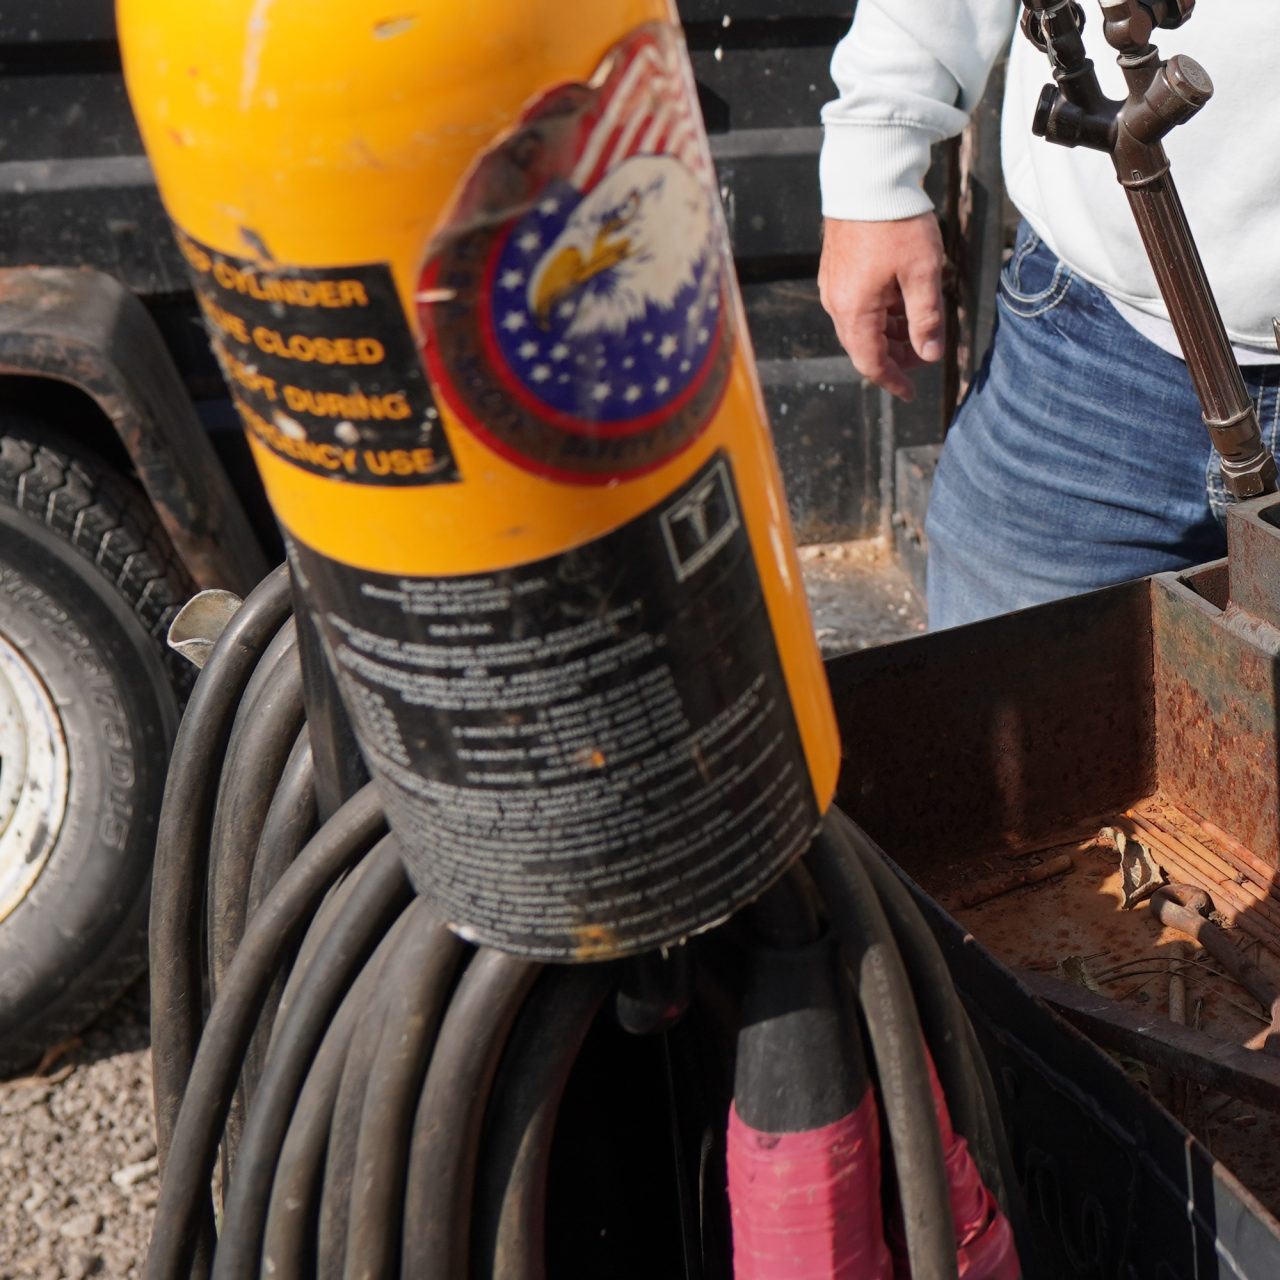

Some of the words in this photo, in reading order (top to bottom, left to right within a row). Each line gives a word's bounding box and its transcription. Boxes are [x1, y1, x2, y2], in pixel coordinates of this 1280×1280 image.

[212, 261, 369, 308] CYLINDER
[251, 326, 385, 365] CLOSED
[282, 384, 411, 420] DURING
[364, 447, 435, 476] USE
